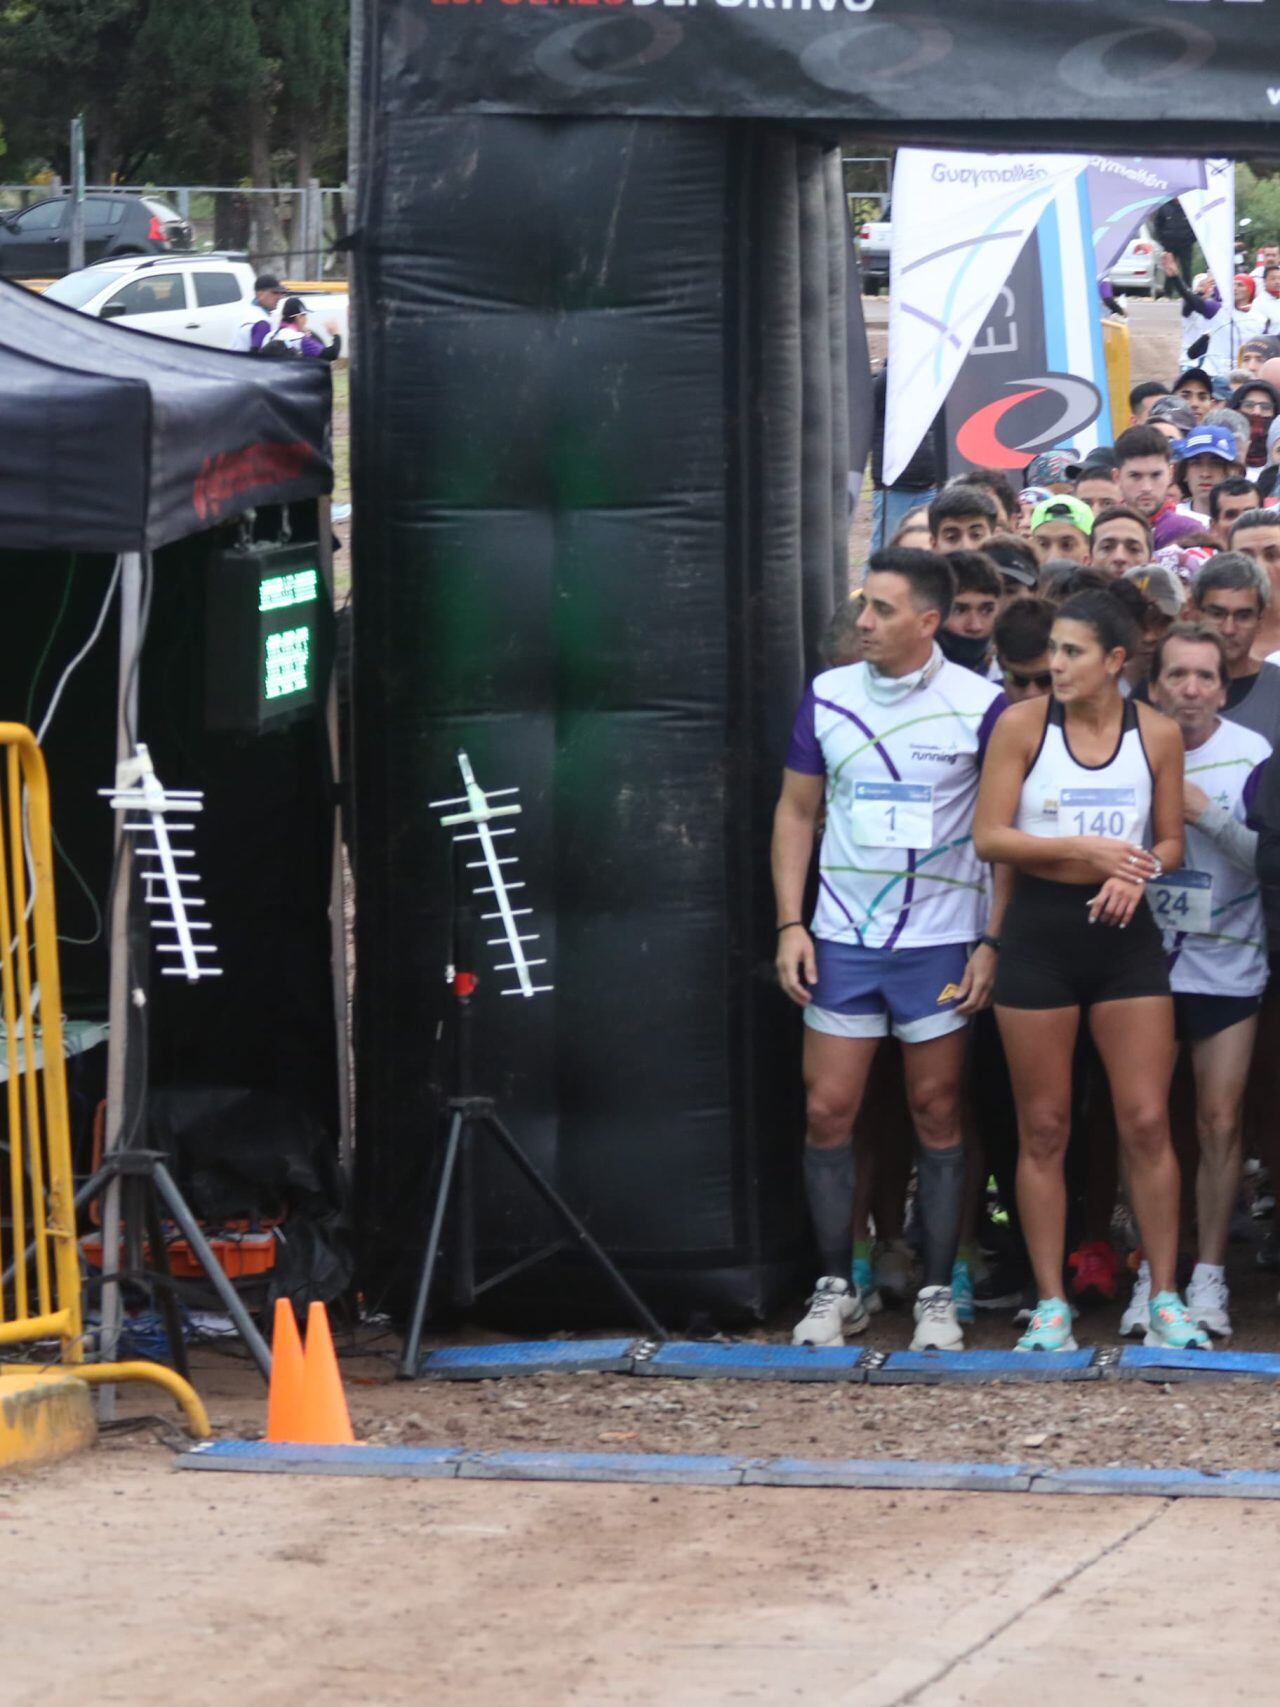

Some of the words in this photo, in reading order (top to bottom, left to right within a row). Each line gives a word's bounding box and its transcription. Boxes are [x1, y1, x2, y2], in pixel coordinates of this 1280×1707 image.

[911, 751, 958, 765] running
[884, 805, 896, 831] 1
[1073, 811, 1125, 837] 140
[1156, 889, 1190, 917] 24
